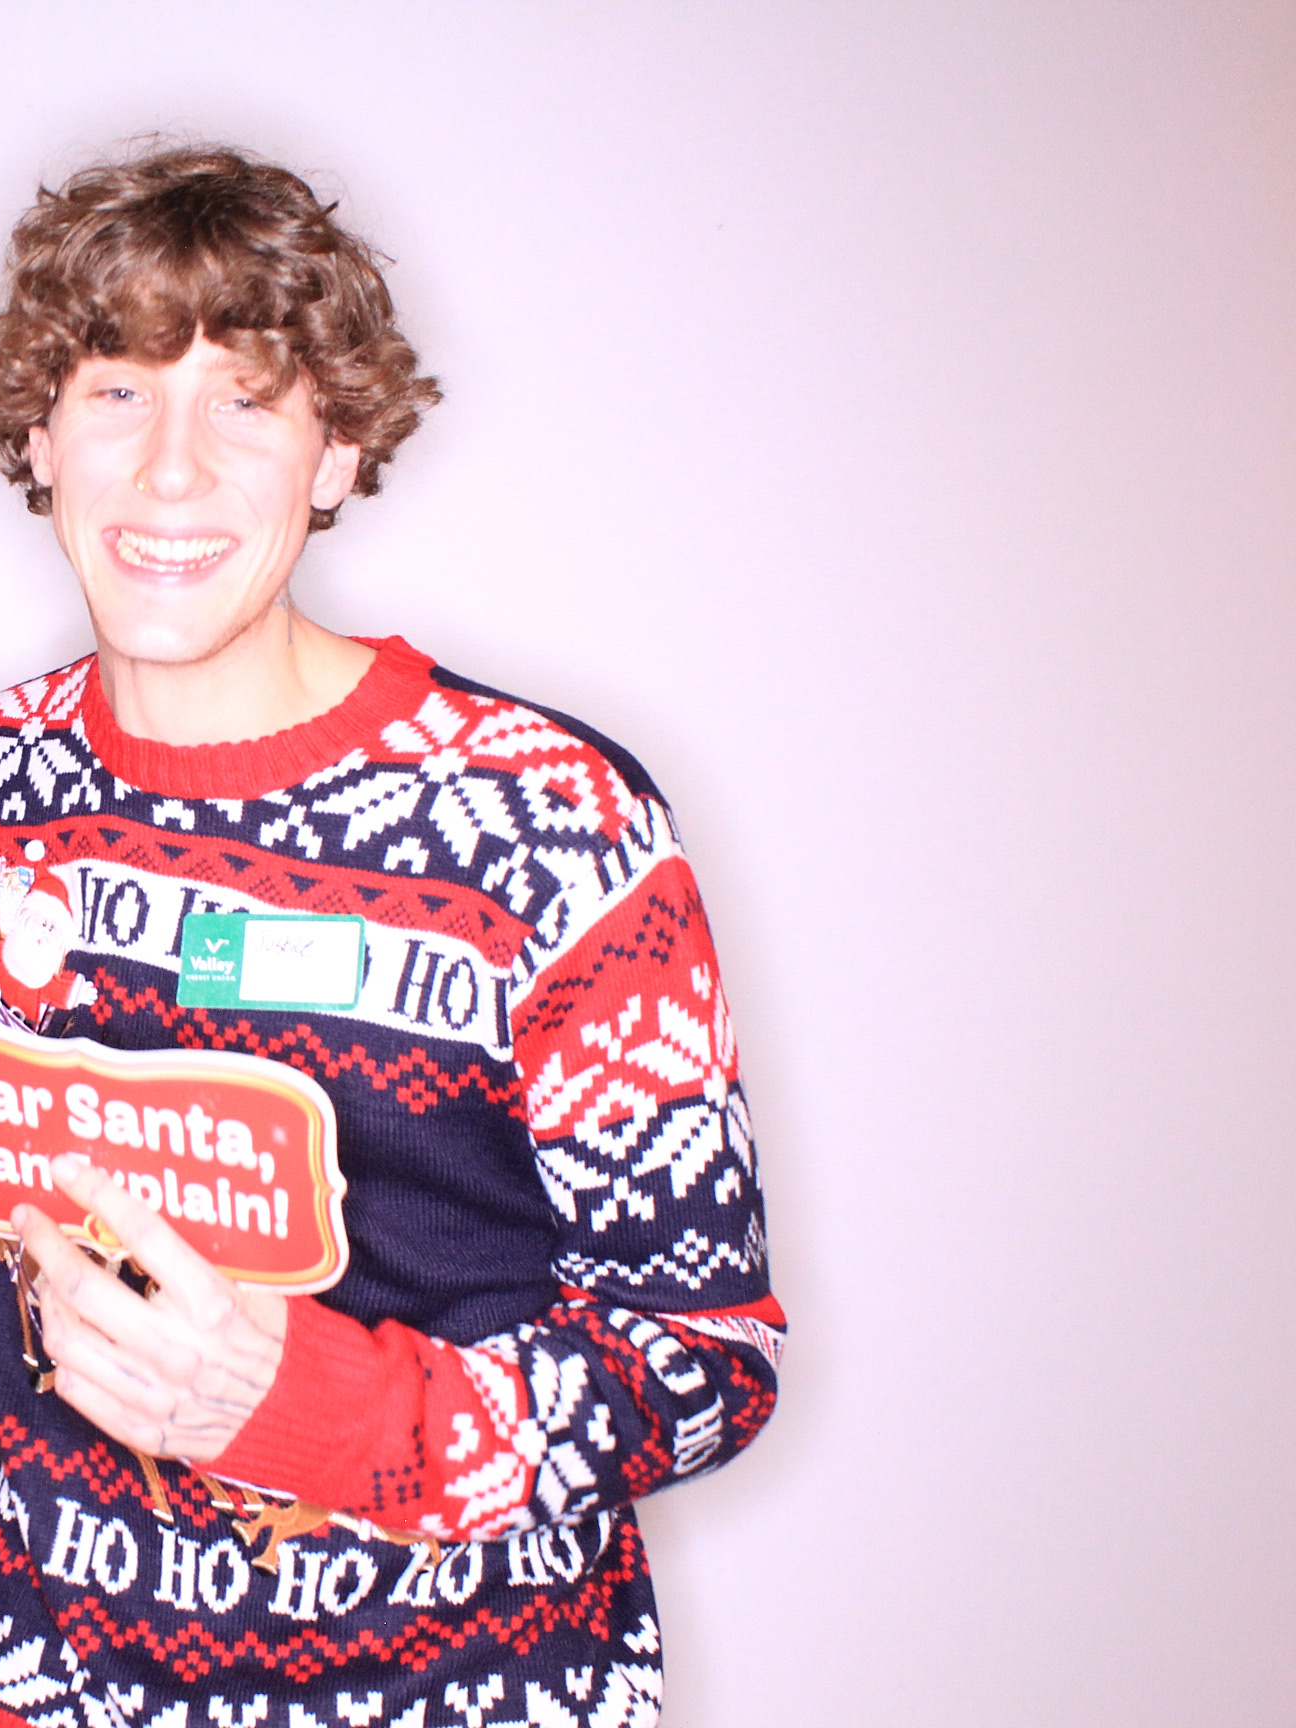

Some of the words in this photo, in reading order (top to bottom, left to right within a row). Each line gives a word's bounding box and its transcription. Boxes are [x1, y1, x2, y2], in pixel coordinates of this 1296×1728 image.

[78, 867, 151, 947] HO
[388, 939, 478, 1031] HO
[190, 956, 235, 975] Valley
[65, 1083, 276, 1184] Santa,
[65, 1151, 290, 1240] plain!
[42, 1497, 139, 1595] HO
[153, 1523, 250, 1613] HO
[268, 1541, 378, 1621] HO
